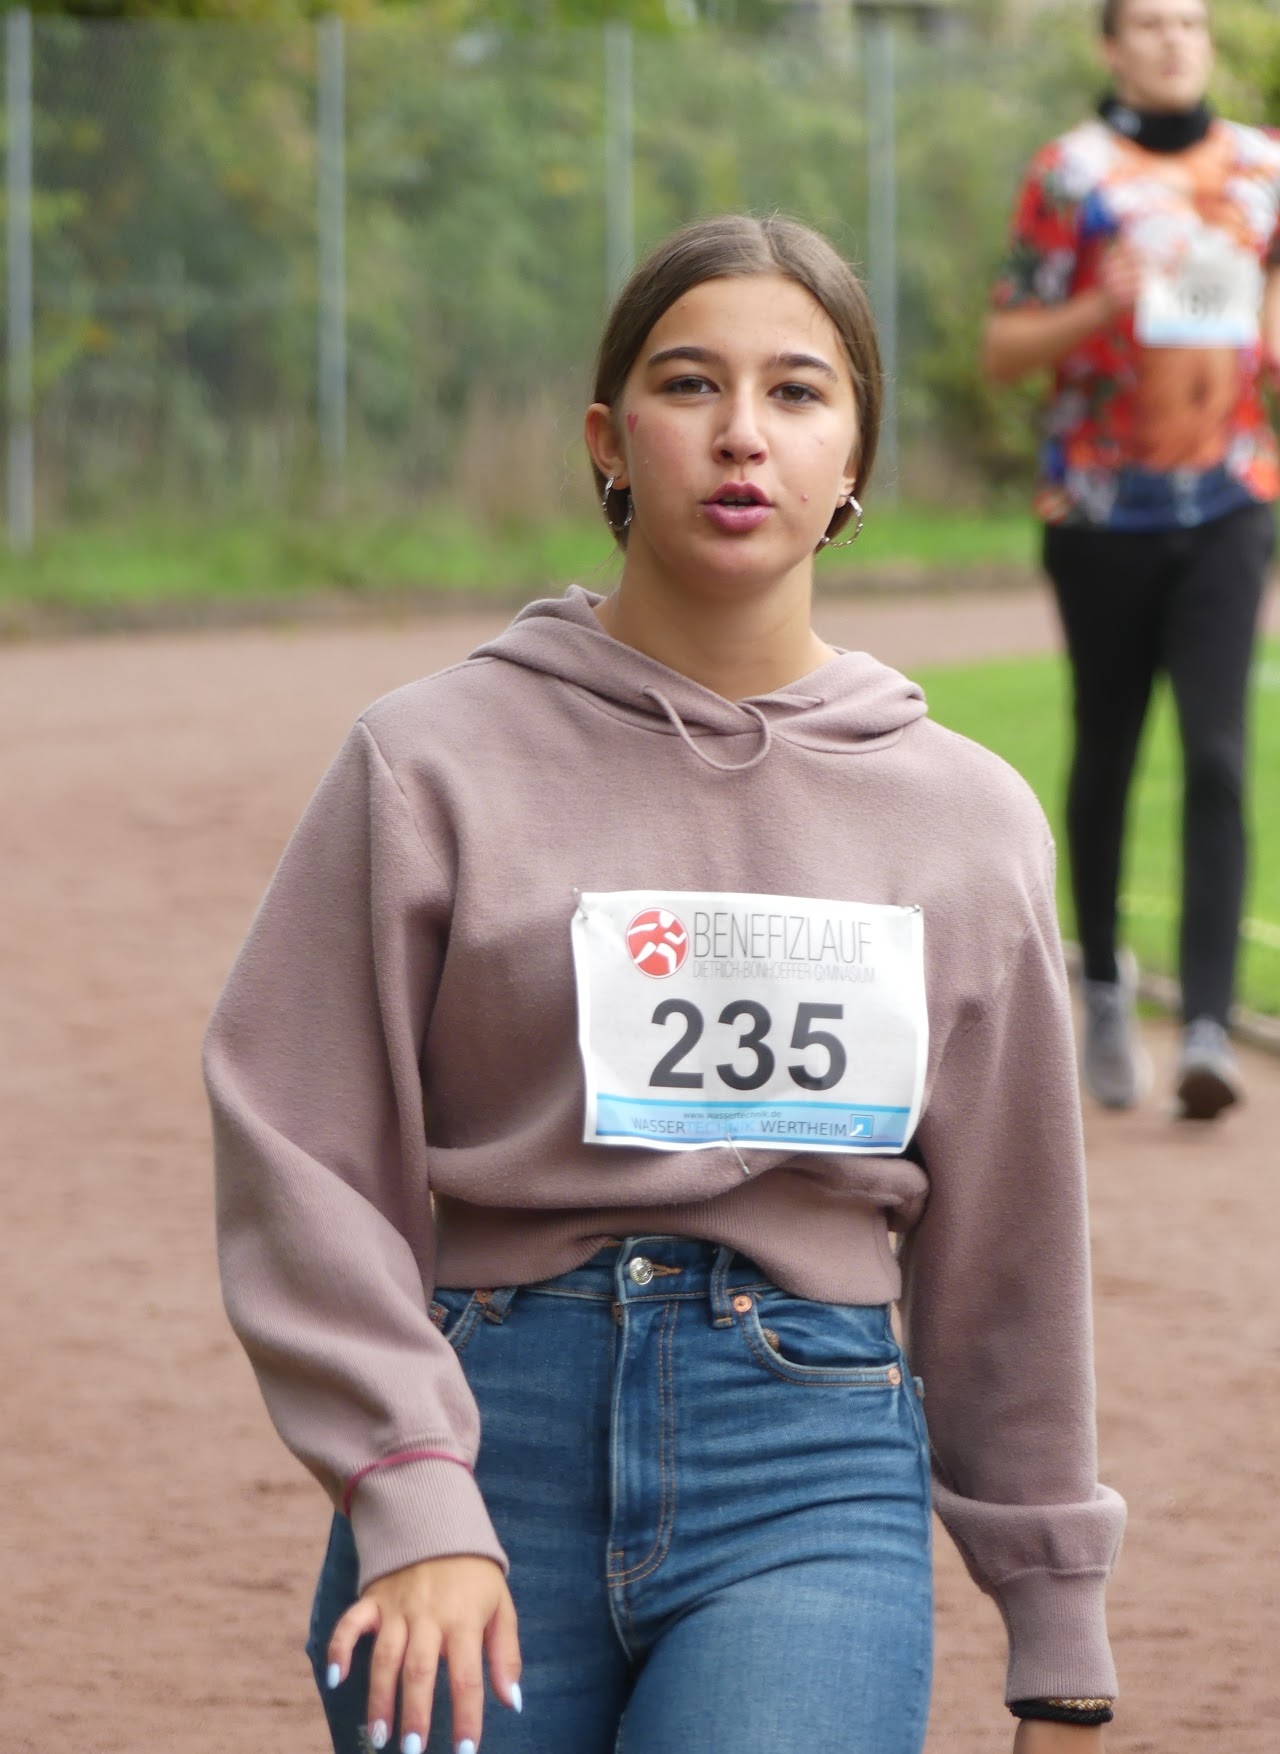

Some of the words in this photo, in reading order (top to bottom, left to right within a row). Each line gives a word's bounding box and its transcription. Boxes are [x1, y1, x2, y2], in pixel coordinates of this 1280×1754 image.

[694, 911, 872, 964] BENEFIZLAUF
[648, 998, 847, 1091] 235
[683, 1110, 783, 1120] www.wassertechnik.de
[760, 1120, 847, 1137] WERTHEIM
